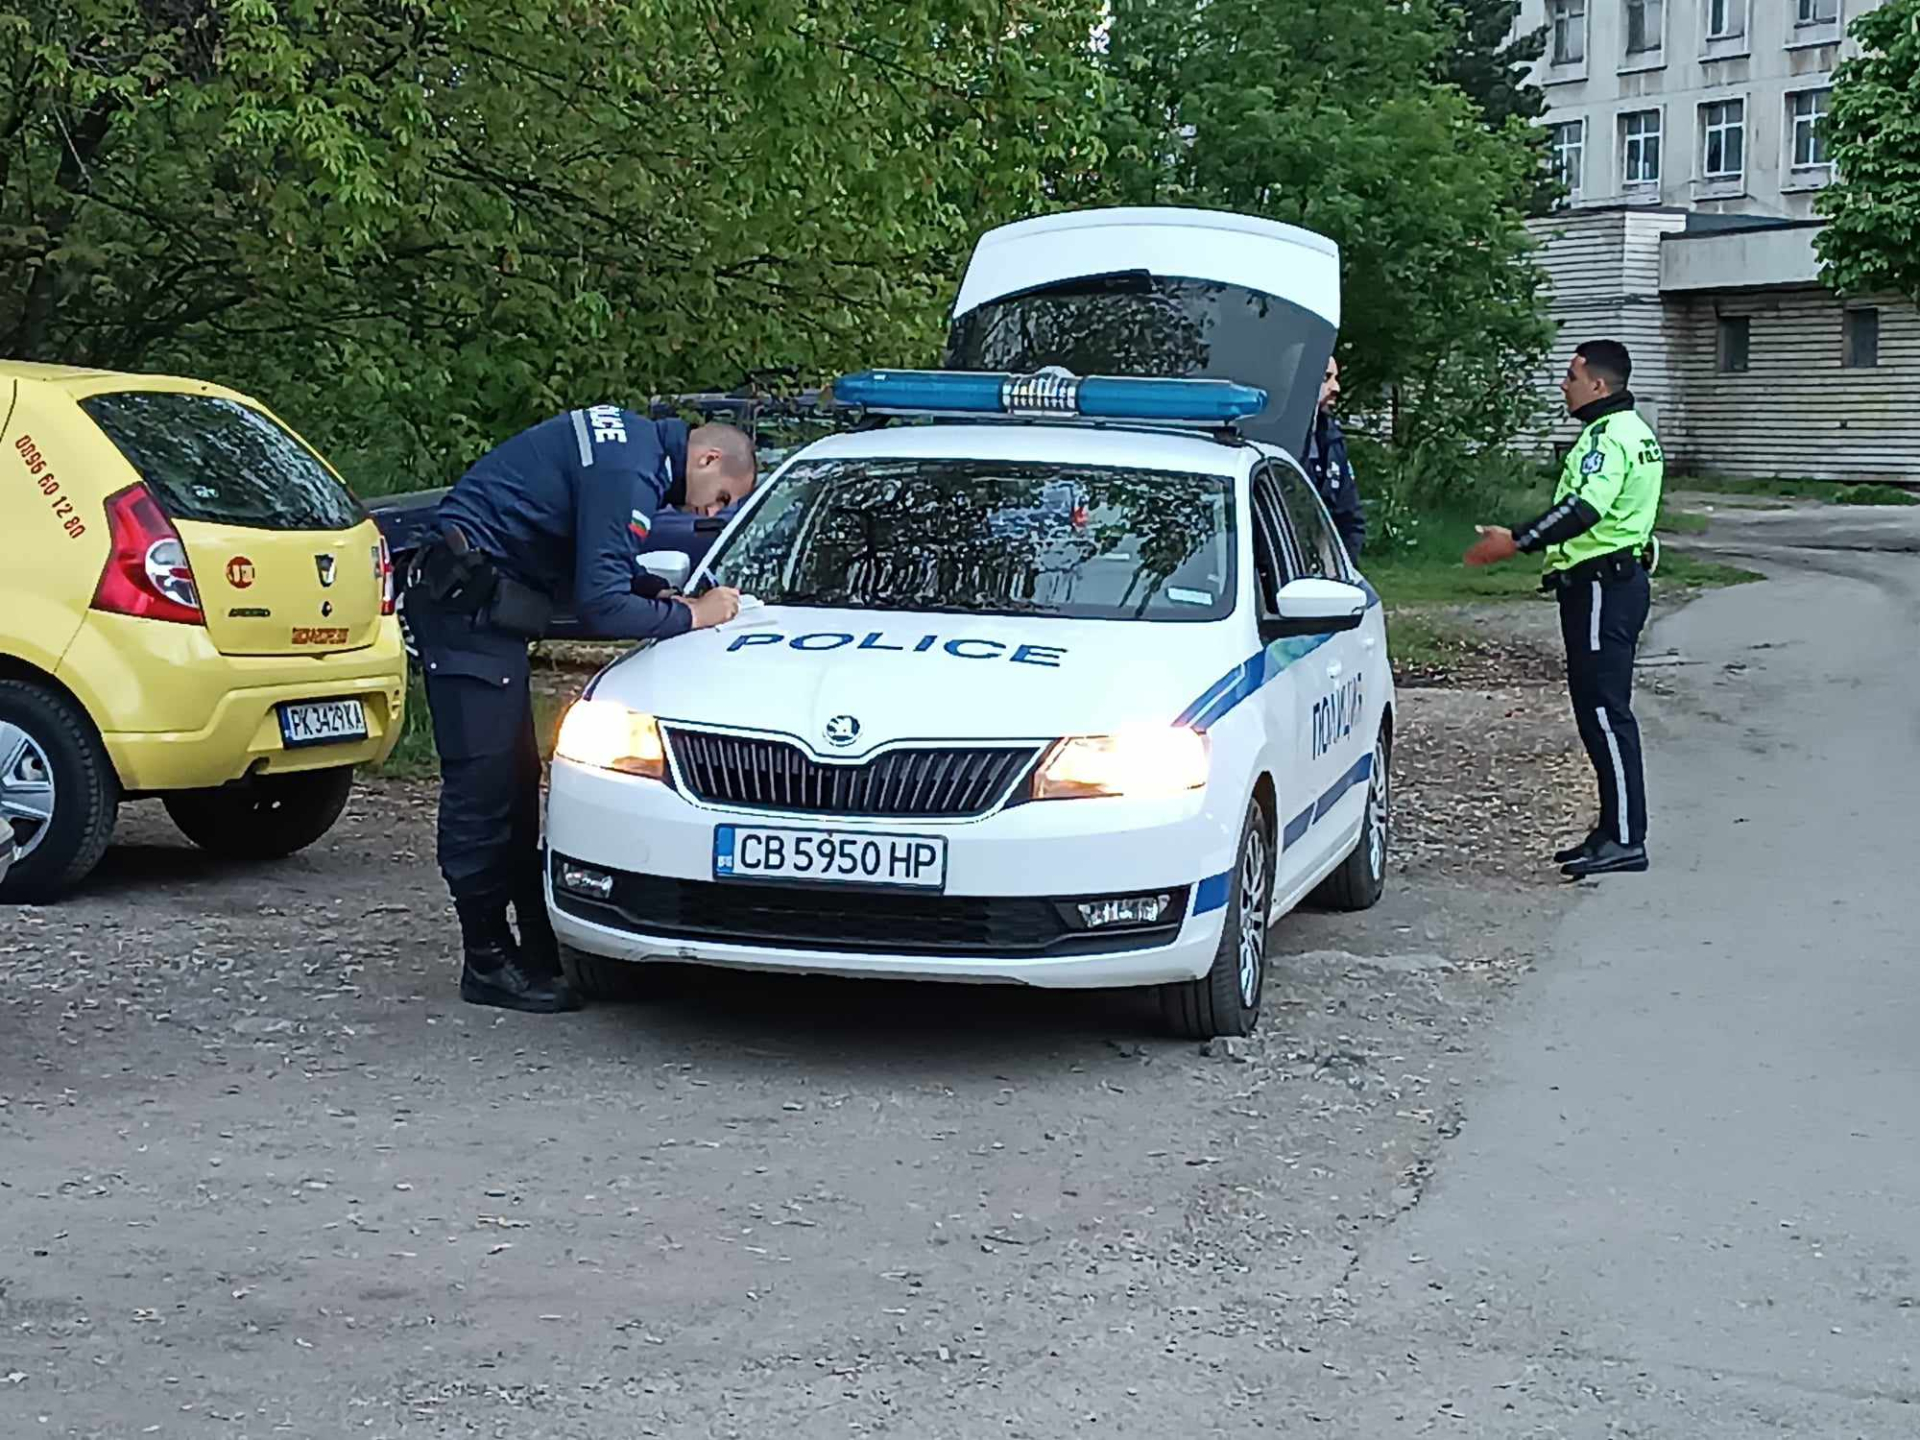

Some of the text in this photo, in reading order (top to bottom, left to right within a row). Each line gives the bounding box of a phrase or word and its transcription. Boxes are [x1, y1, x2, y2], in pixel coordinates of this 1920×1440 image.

[37, 472, 60, 496] 60
[51, 495, 74, 519] 12
[63, 515, 86, 539] 80
[725, 631, 1069, 668] POLICE
[740, 833, 937, 879] CB 5950 HP
